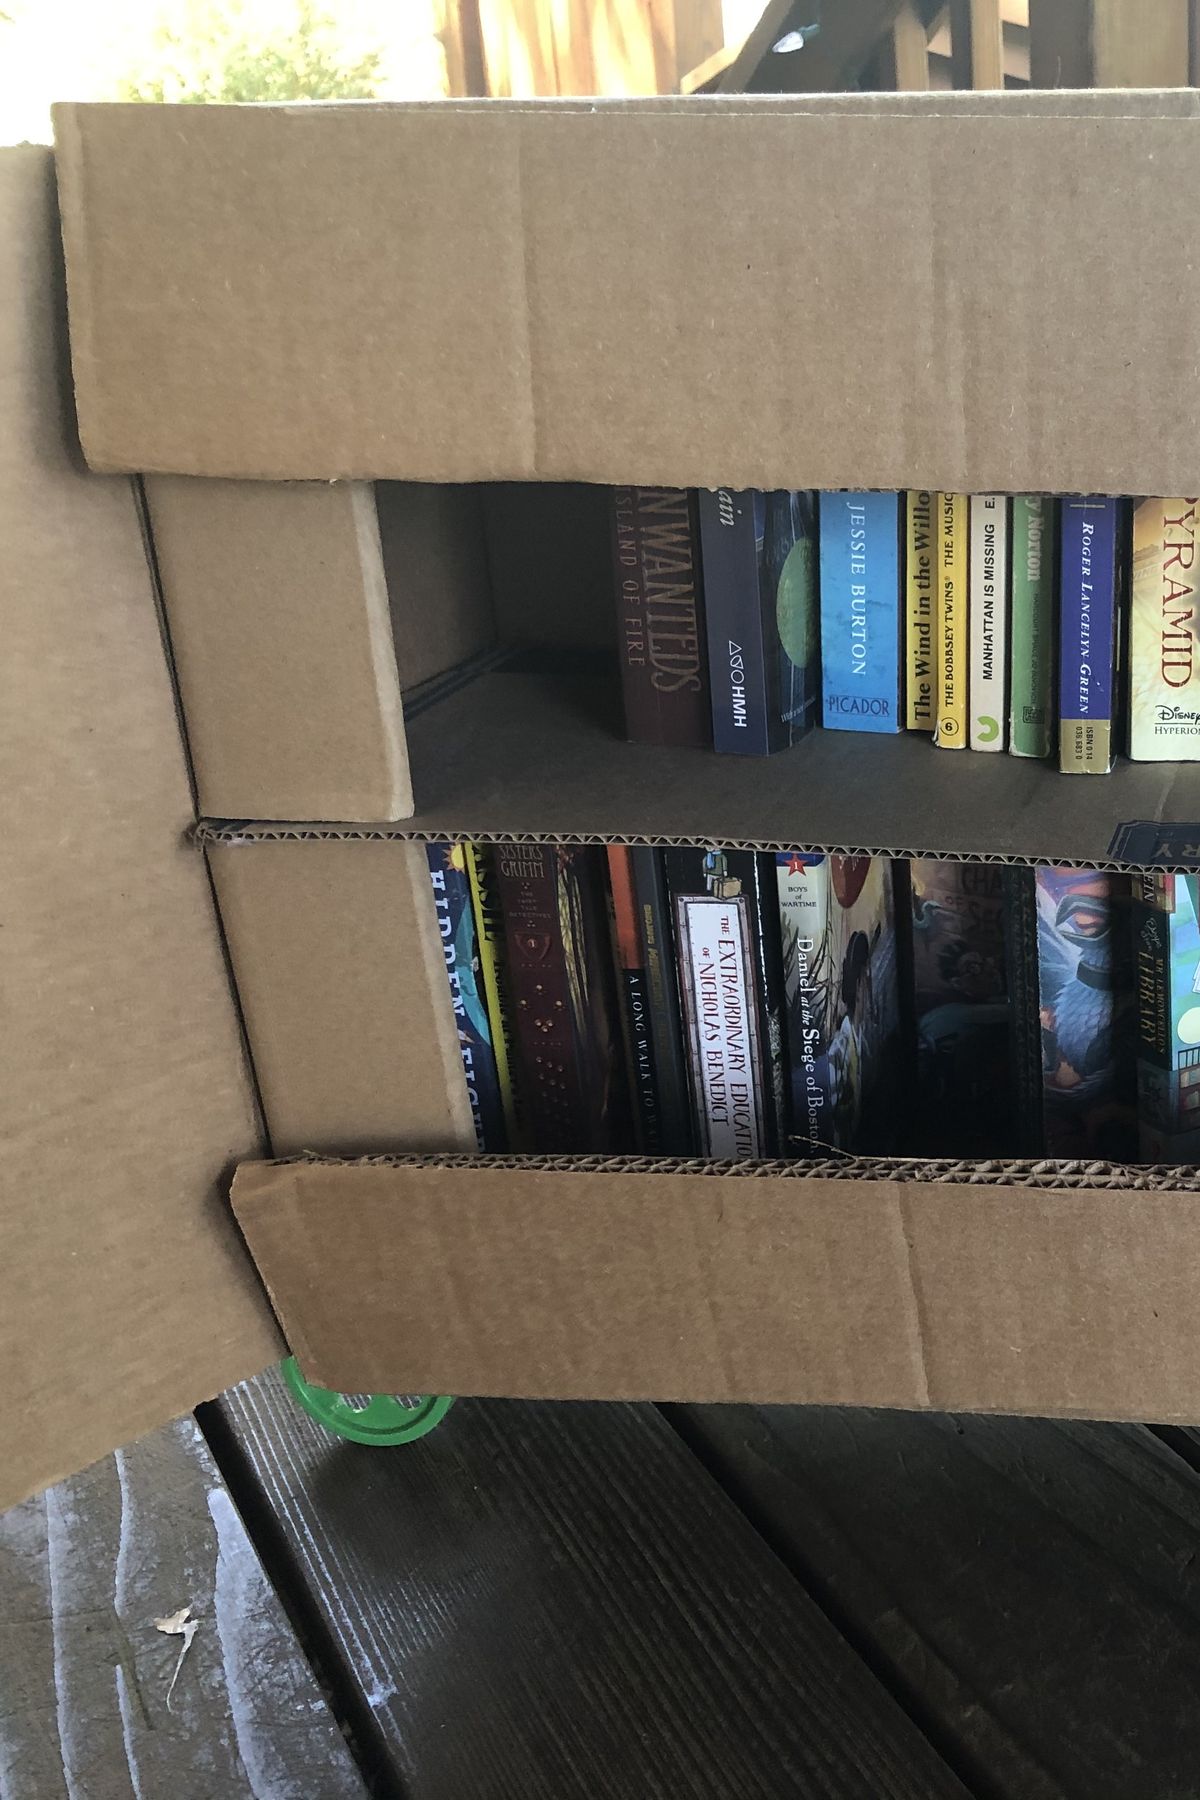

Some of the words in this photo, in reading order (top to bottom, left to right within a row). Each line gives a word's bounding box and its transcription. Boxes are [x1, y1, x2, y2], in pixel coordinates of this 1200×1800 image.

[847, 502, 866, 575] JESSIE
[944, 540, 954, 567] THE
[984, 524, 995, 581] MISSING
[1027, 515, 1044, 581] Norton
[1081, 522, 1094, 576] ROGER
[622, 580, 640, 605] OF
[913, 556, 931, 590] the
[984, 584, 994, 597] IS
[1161, 497, 1199, 688] YRAMID
[914, 596, 931, 616] in
[1080, 582, 1093, 657] LANCELYN
[625, 617, 646, 666] FIRE
[851, 584, 866, 676] BURTON
[914, 621, 931, 678] Wind
[982, 601, 994, 680] MANHATTAN
[945, 625, 954, 686] BOBBSEY
[732, 686, 747, 727] HMH
[827, 696, 890, 716] PICADOR
[914, 682, 931, 721] The
[945, 687, 954, 708] THE
[1079, 663, 1092, 714] GREEN
[945, 722, 953, 731] 6
[1086, 726, 1094, 745] ISBN
[499, 844, 544, 860] SISTERS
[500, 860, 545, 879] GRIMM
[720, 915, 730, 935] THE
[702, 947, 709, 959] OF
[797, 937, 816, 993] Daniel
[629, 974, 639, 985] A
[1138, 950, 1156, 1048] LIBRARY
[631, 991, 647, 1032] LONG
[698, 961, 721, 1041] NICHOLAS
[718, 939, 746, 1074] EXTRAORDINARY
[802, 1005, 814, 1030] the
[638, 1039, 650, 1081] WALK
[802, 1028, 820, 1073] Siege
[707, 1050, 729, 1127] BENEDICT
[805, 1076, 823, 1093] of
